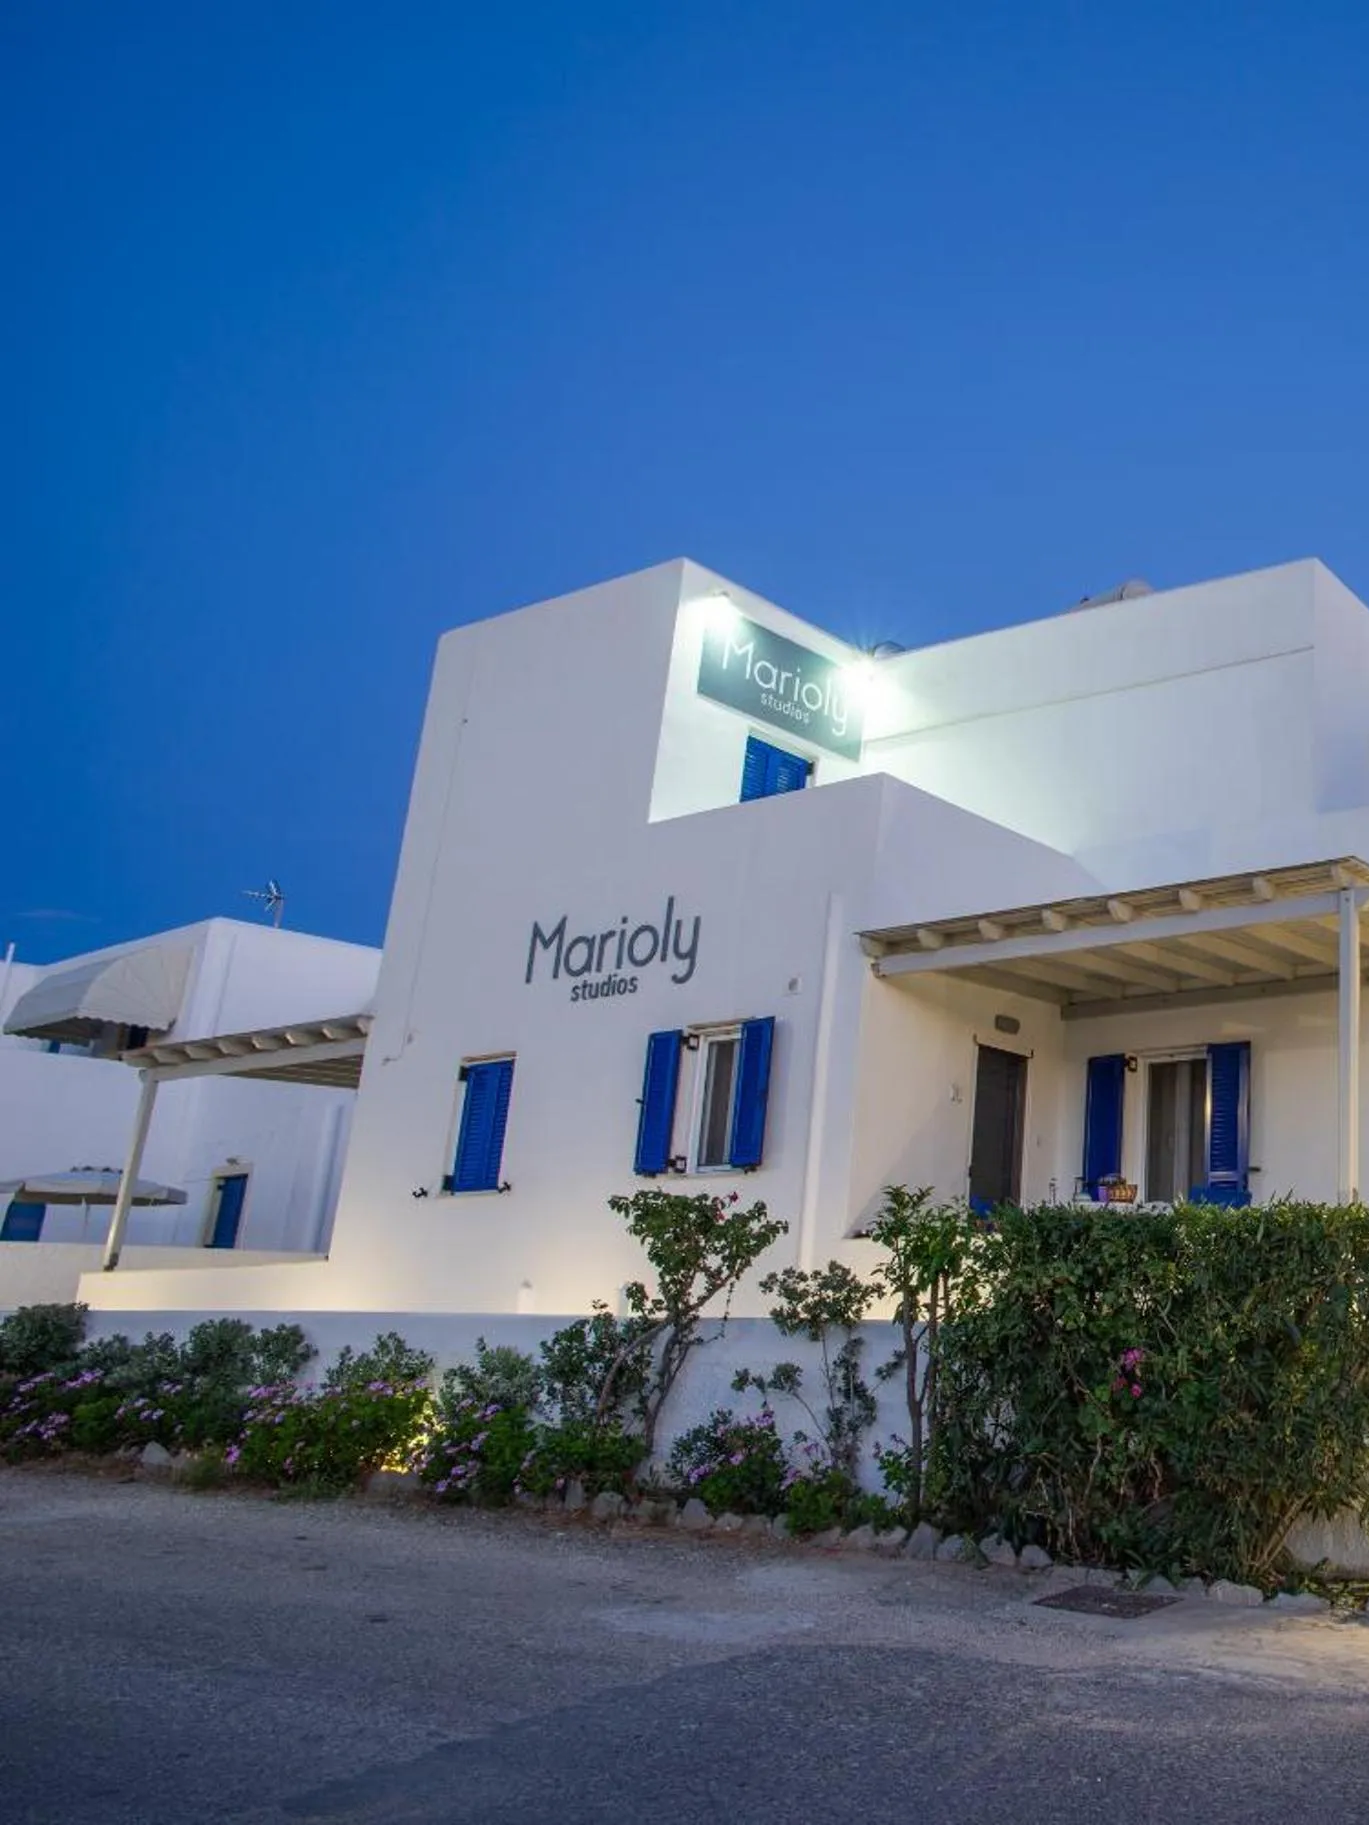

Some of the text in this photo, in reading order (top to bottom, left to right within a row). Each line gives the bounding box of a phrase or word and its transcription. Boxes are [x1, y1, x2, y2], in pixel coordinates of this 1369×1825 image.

[723, 638, 848, 736] Marioly
[761, 692, 809, 724] studios
[525, 895, 701, 985] Marioly
[570, 974, 639, 1002] studios
